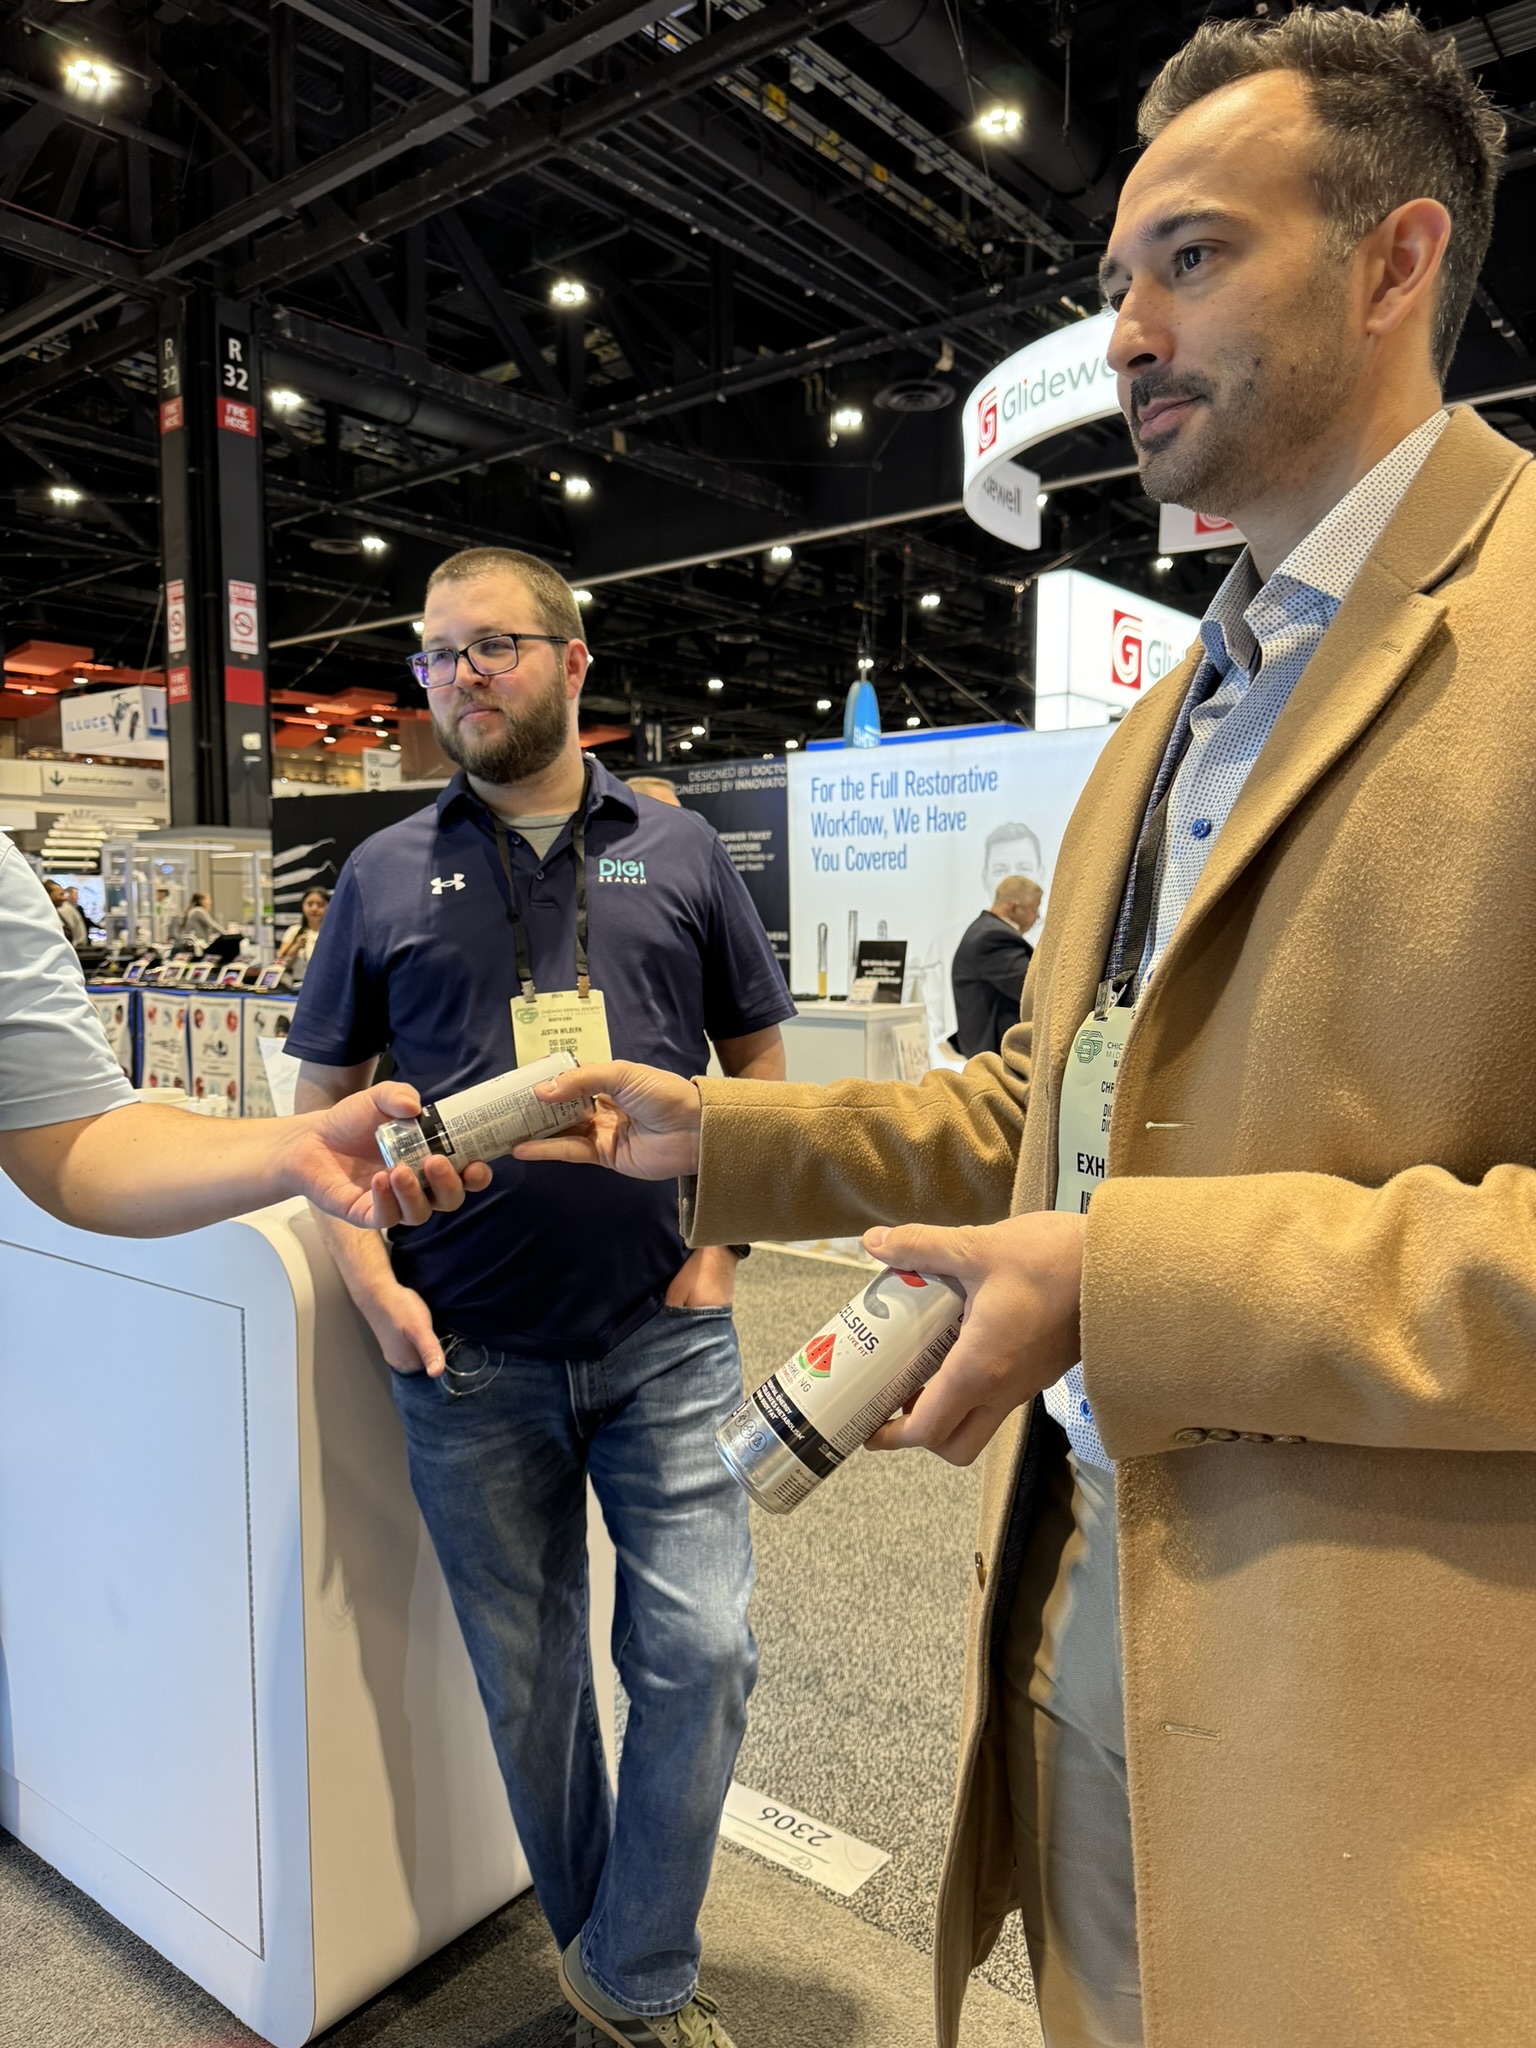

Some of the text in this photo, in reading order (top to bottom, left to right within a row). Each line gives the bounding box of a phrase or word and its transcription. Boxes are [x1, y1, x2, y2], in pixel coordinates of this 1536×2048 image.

[165, 338, 174, 360] R
[228, 337, 243, 362] R
[162, 365, 177, 389] 32
[223, 364, 249, 392] 32
[1002, 357, 1116, 421] Glidewe
[982, 474, 1021, 516] dewell
[688, 763, 787, 782] DESIGNED BY DOCTO
[811, 765, 998, 803] For the Full Restorative
[675, 776, 787, 796] ONEERED BY INNOVATO
[810, 804, 967, 840] Workflow, We Have
[599, 858, 645, 878] DIGI
[811, 843, 907, 872] You Covered
[598, 876, 647, 885] SEARCH
[541, 1028, 558, 1036] JUSTIN
[560, 1037, 577, 1045] SEARCH
[1107, 1042, 1124, 1051] CHIC
[847, 1333, 868, 1358] LIVE FIT
[787, 1358, 813, 1394] PARKLNG
[767, 1408, 778, 1420] FAT
[775, 1394, 793, 1415] ENERGY
[775, 1407, 803, 1441] METABOLISM
[757, 1806, 833, 1847] 2306
